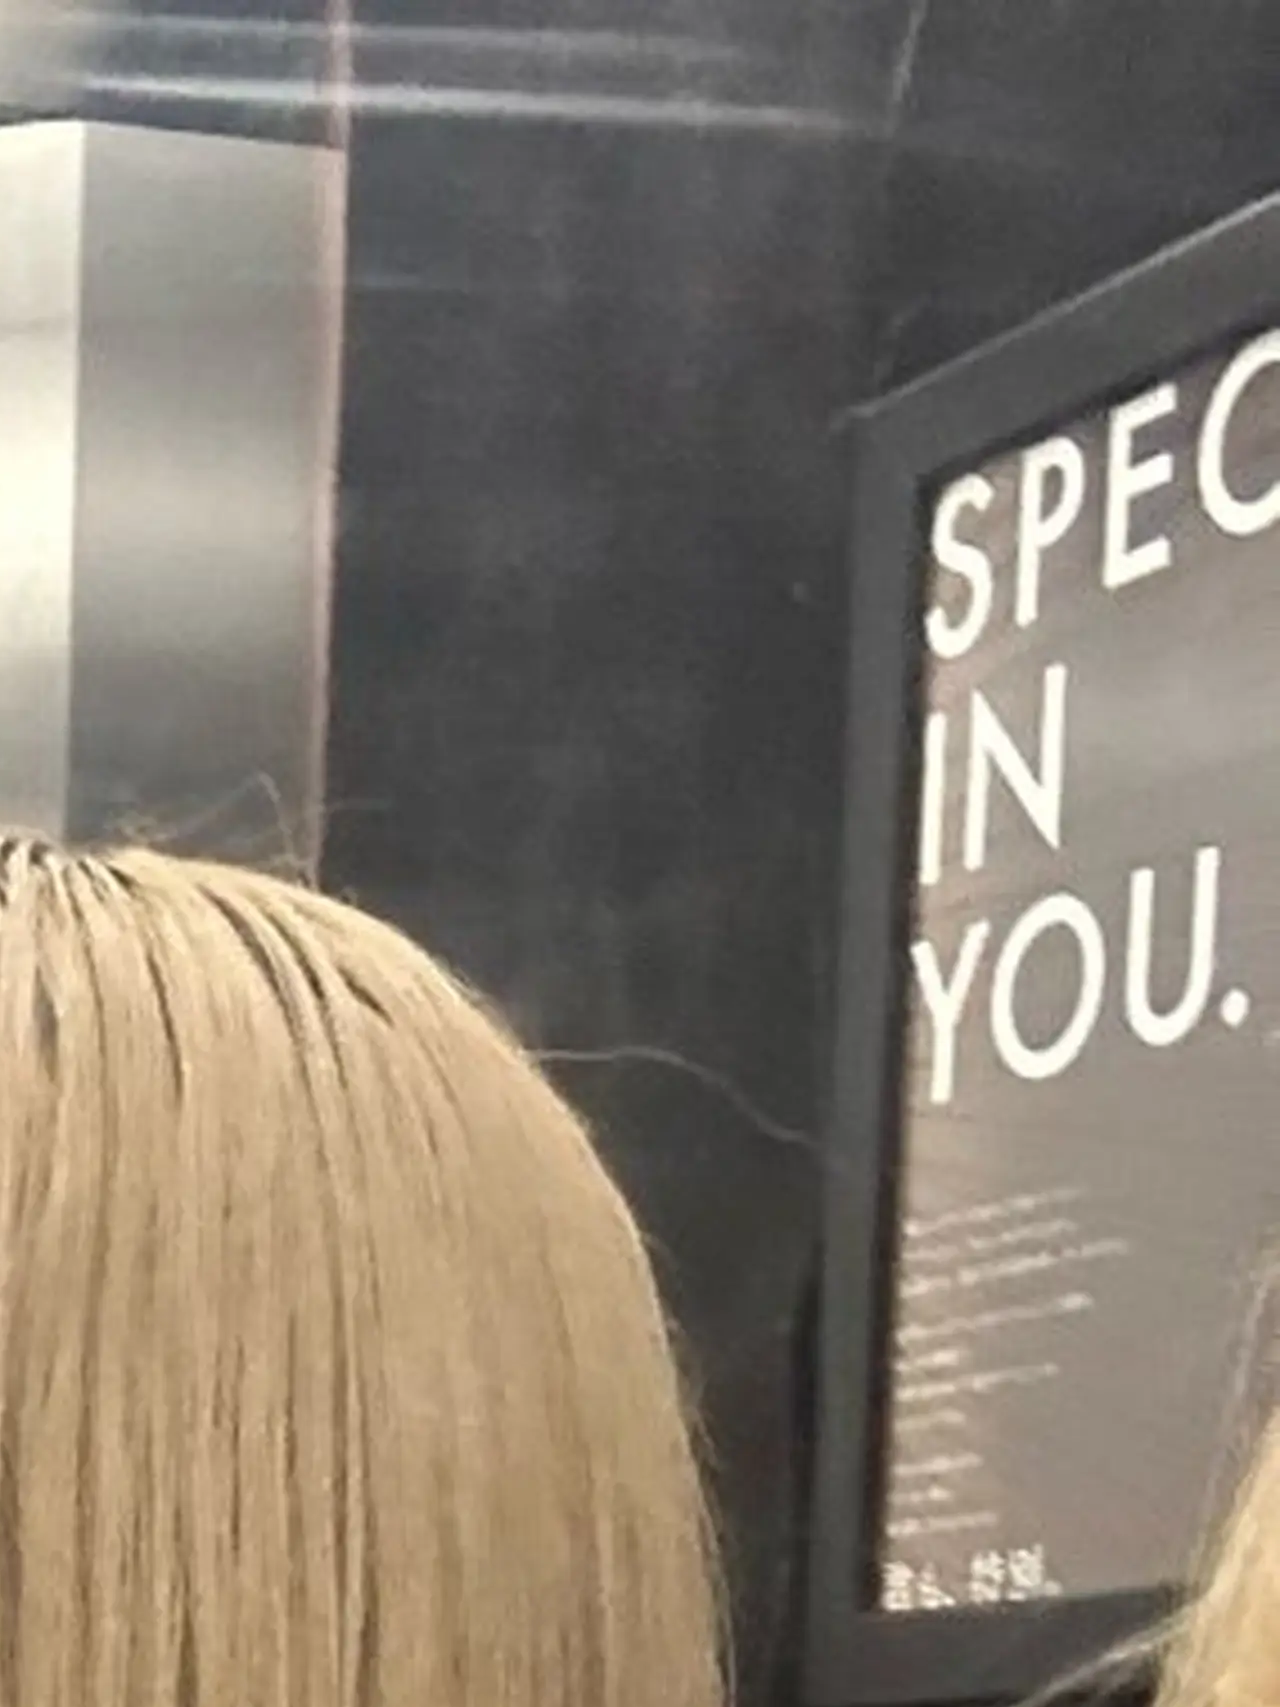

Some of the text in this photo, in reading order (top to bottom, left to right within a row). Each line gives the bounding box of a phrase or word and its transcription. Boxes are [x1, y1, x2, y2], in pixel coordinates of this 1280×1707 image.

[924, 328, 1280, 660] SPEC
[919, 664, 1068, 886] IN
[910, 846, 1251, 1105] YOU.
